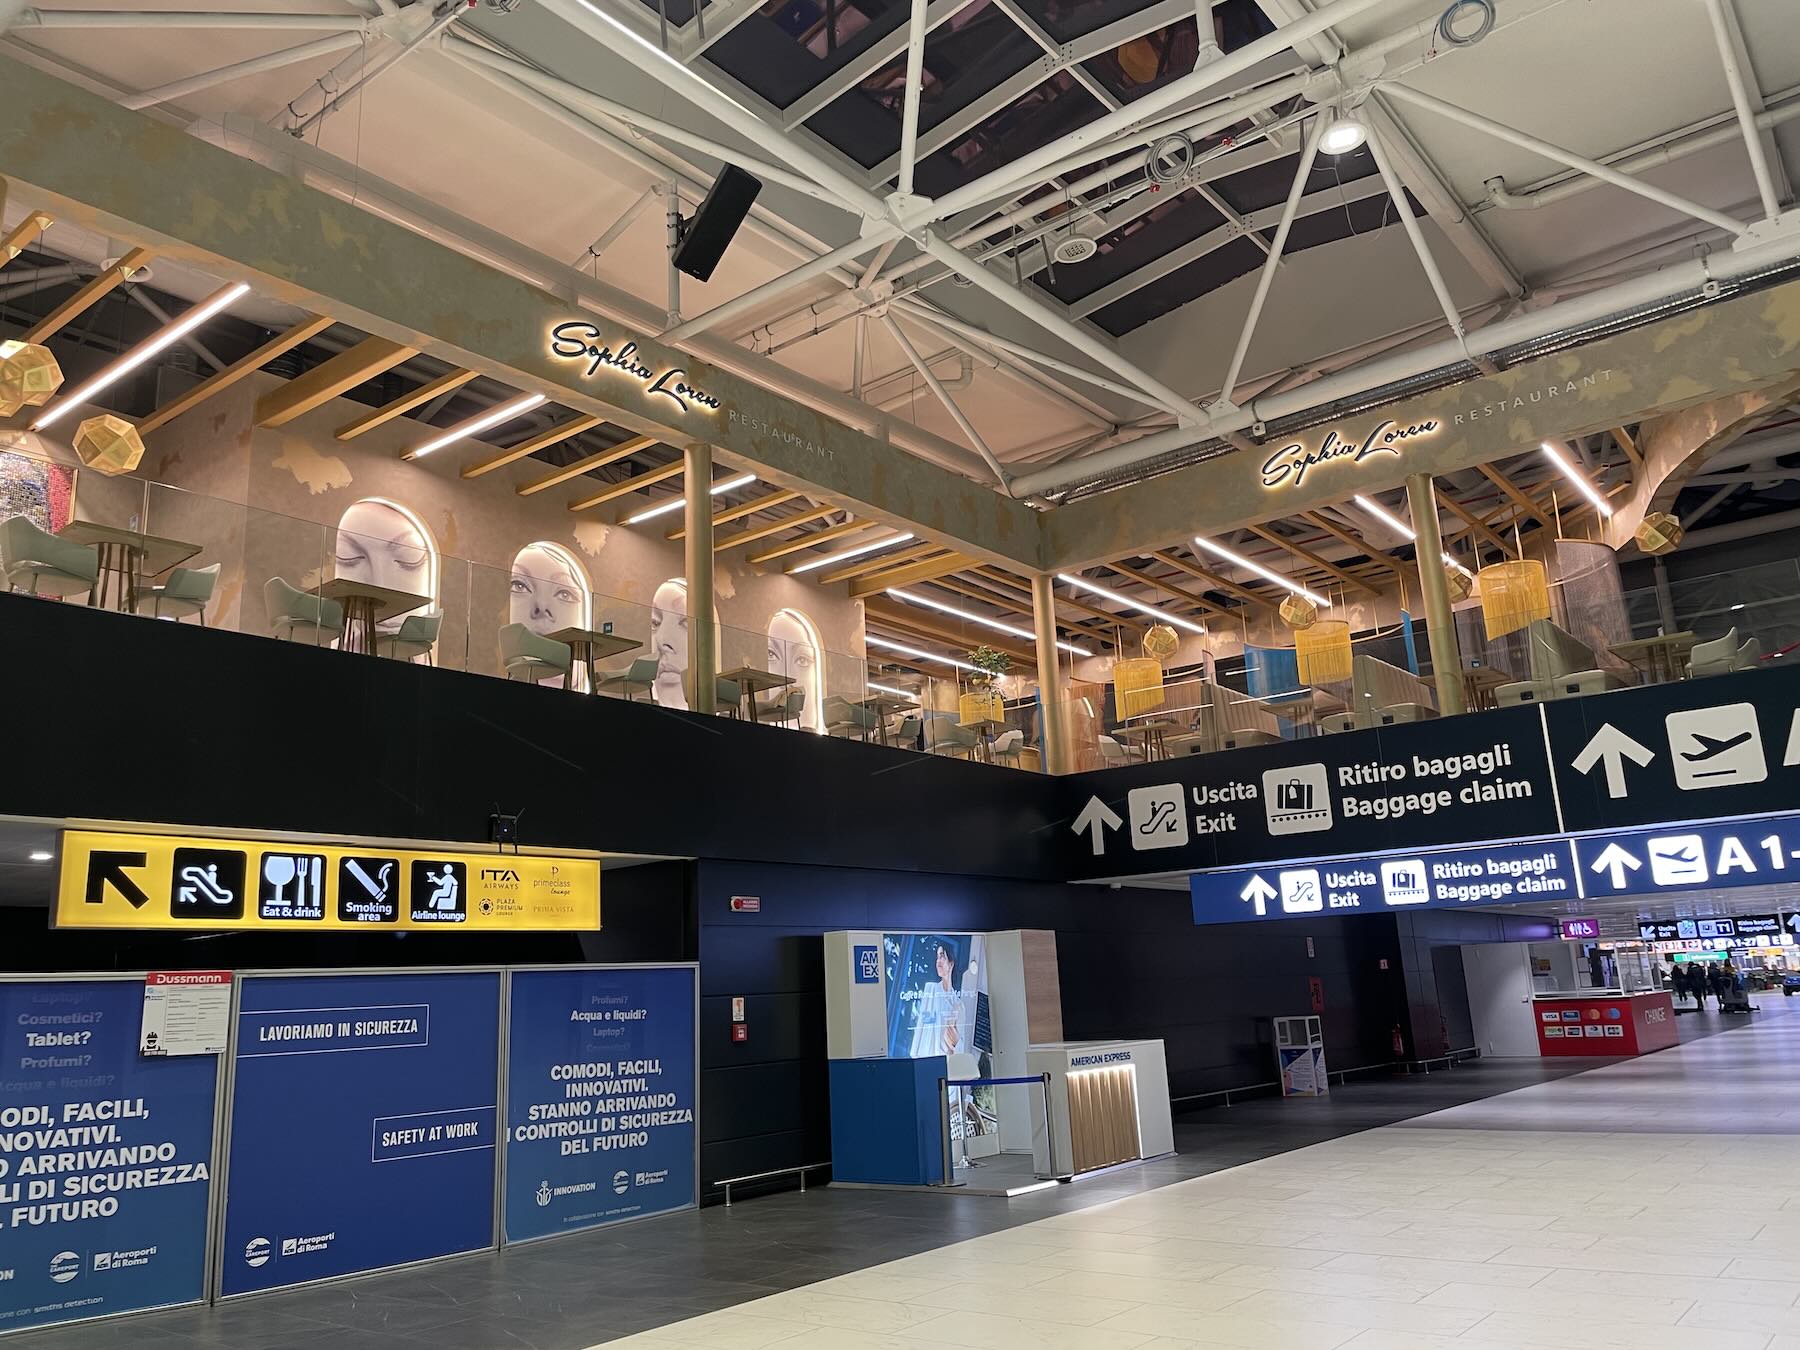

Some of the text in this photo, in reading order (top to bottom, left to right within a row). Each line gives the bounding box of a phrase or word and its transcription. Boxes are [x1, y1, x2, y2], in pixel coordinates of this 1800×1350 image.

[552, 322, 835, 461] Sophia Loren RESTAURANT
[1262, 369, 1613, 486] Sophia Loren RESTAURANT
[1338, 744, 1511, 787] Ritiro bagagli
[1192, 782, 1258, 806] Uscita
[1342, 778, 1532, 820] Baggage claim
[1196, 812, 1236, 835] Exit
[1433, 853, 1557, 879] Ritiro bagagli
[481, 869, 520, 881] ITA
[1326, 871, 1377, 888] Uscita
[533, 879, 571, 888] primeclass
[1436, 876, 1566, 901] Baggage claim
[346, 902, 392, 914] Smoking
[1329, 893, 1360, 909] Exit
[263, 906, 321, 918] Eat & drink
[358, 913, 380, 921] area
[412, 911, 465, 921] Airline lounge
[1717, 923, 1730, 932] T1
[860, 950, 878, 965] AM
[156, 974, 222, 983] Dussmann
[863, 965, 879, 978] EX
[17, 1011, 103, 1025] Cosmetici?
[570, 1009, 647, 1023] Acqua e liquidi?
[1645, 1007, 1666, 1025] CHANGE
[259, 1019, 418, 1041] LAVORIAMO IN SICUREZZA
[593, 1027, 625, 1038] Laptop?
[26, 1031, 91, 1047] Tablet?
[21, 1054, 92, 1069] Profumi?
[1071, 1051, 1131, 1067] AMERICAN EXPRESS
[550, 1059, 662, 1080] COMODI, FACILI,
[565, 1078, 649, 1098] INNOVATIVI.
[1, 1098, 149, 1127] ODI, FACILI,
[528, 1093, 676, 1121] STANNO ARRIVANDO
[515, 1118, 597, 1142] CONTROLLI
[602, 1117, 615, 1132] DI
[619, 1109, 693, 1130] SICUREZZA
[382, 1122, 478, 1147] SAFETY AT WORK
[561, 1131, 648, 1156] DEL FUTURO
[17, 1142, 176, 1176] ARRIVANDO
[28, 1180, 55, 1200] DI
[63, 1162, 209, 1196] SICUREZZA
[554, 1182, 596, 1196] INNOVATION
[11, 1197, 119, 1227] FUTURO
[297, 1232, 335, 1245] Aeroporti
[112, 1246, 157, 1259] Aeroporti
[297, 1243, 328, 1253] di Roma
[112, 1257, 148, 1268] di Roma
